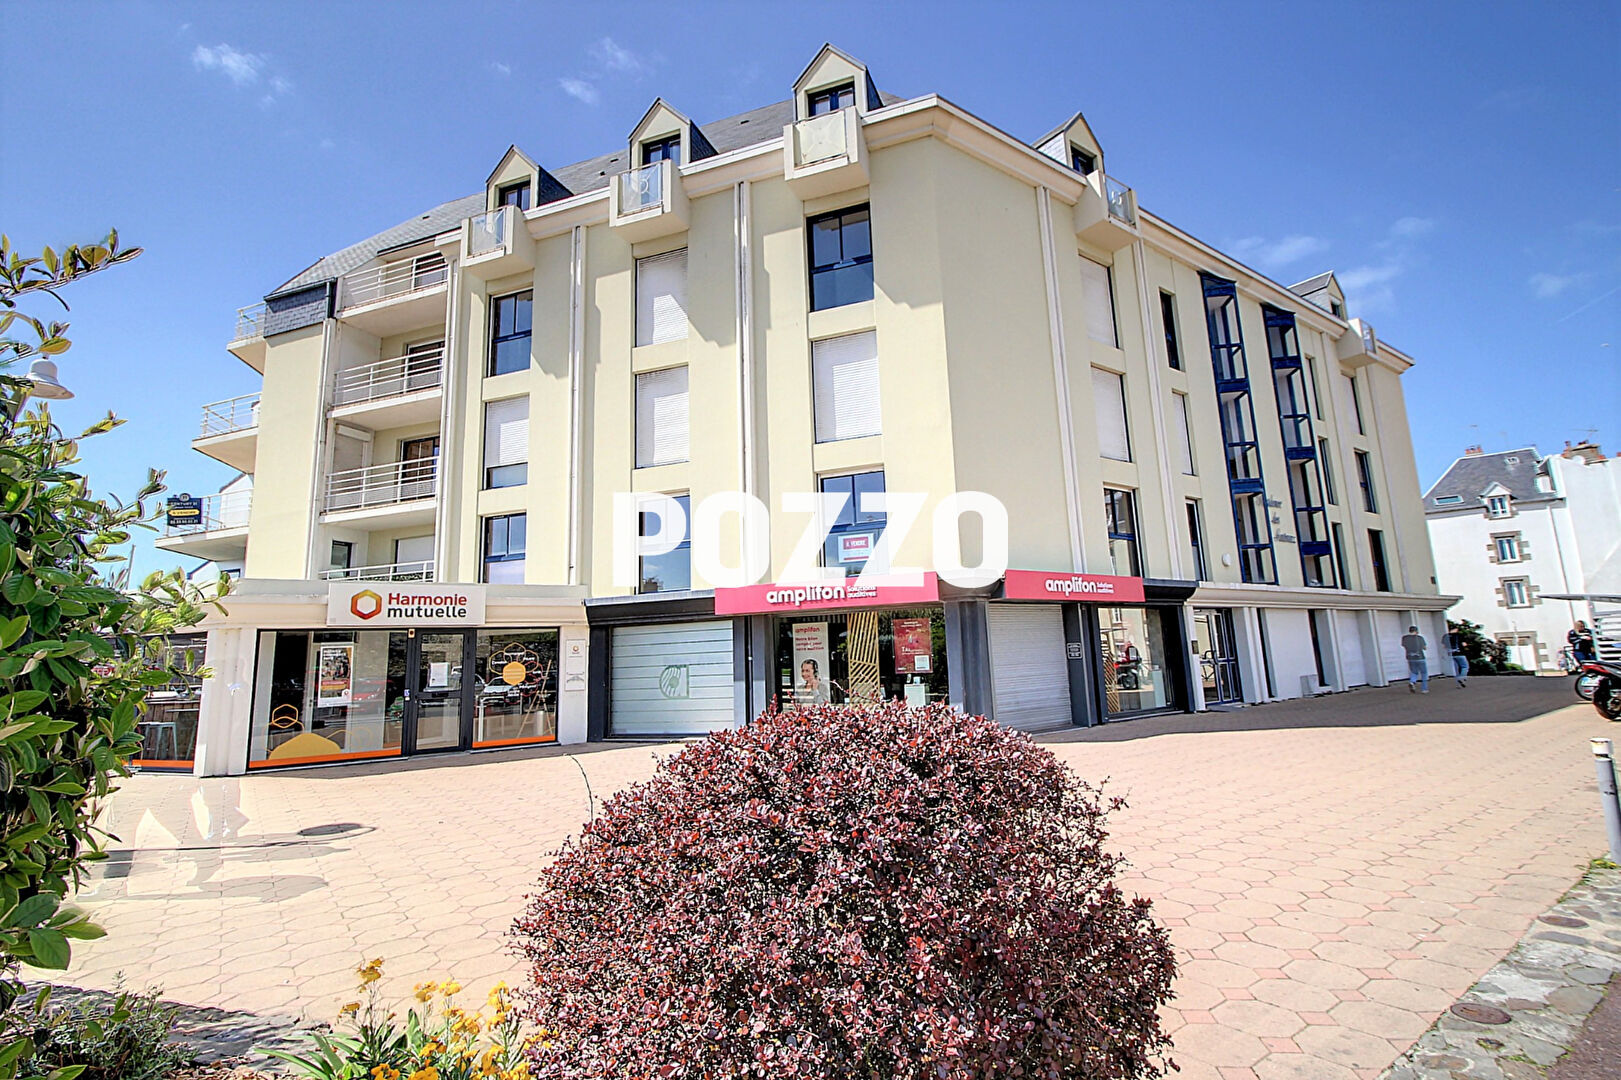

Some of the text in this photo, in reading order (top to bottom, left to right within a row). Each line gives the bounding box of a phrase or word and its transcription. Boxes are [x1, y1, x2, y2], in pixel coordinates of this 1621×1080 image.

[1045, 576, 1097, 597] amplifon
[388, 592, 468, 606] Harmonie
[766, 585, 846, 606] amplifon
[387, 606, 467, 618] mutuelle
[795, 626, 821, 634] amplifon
